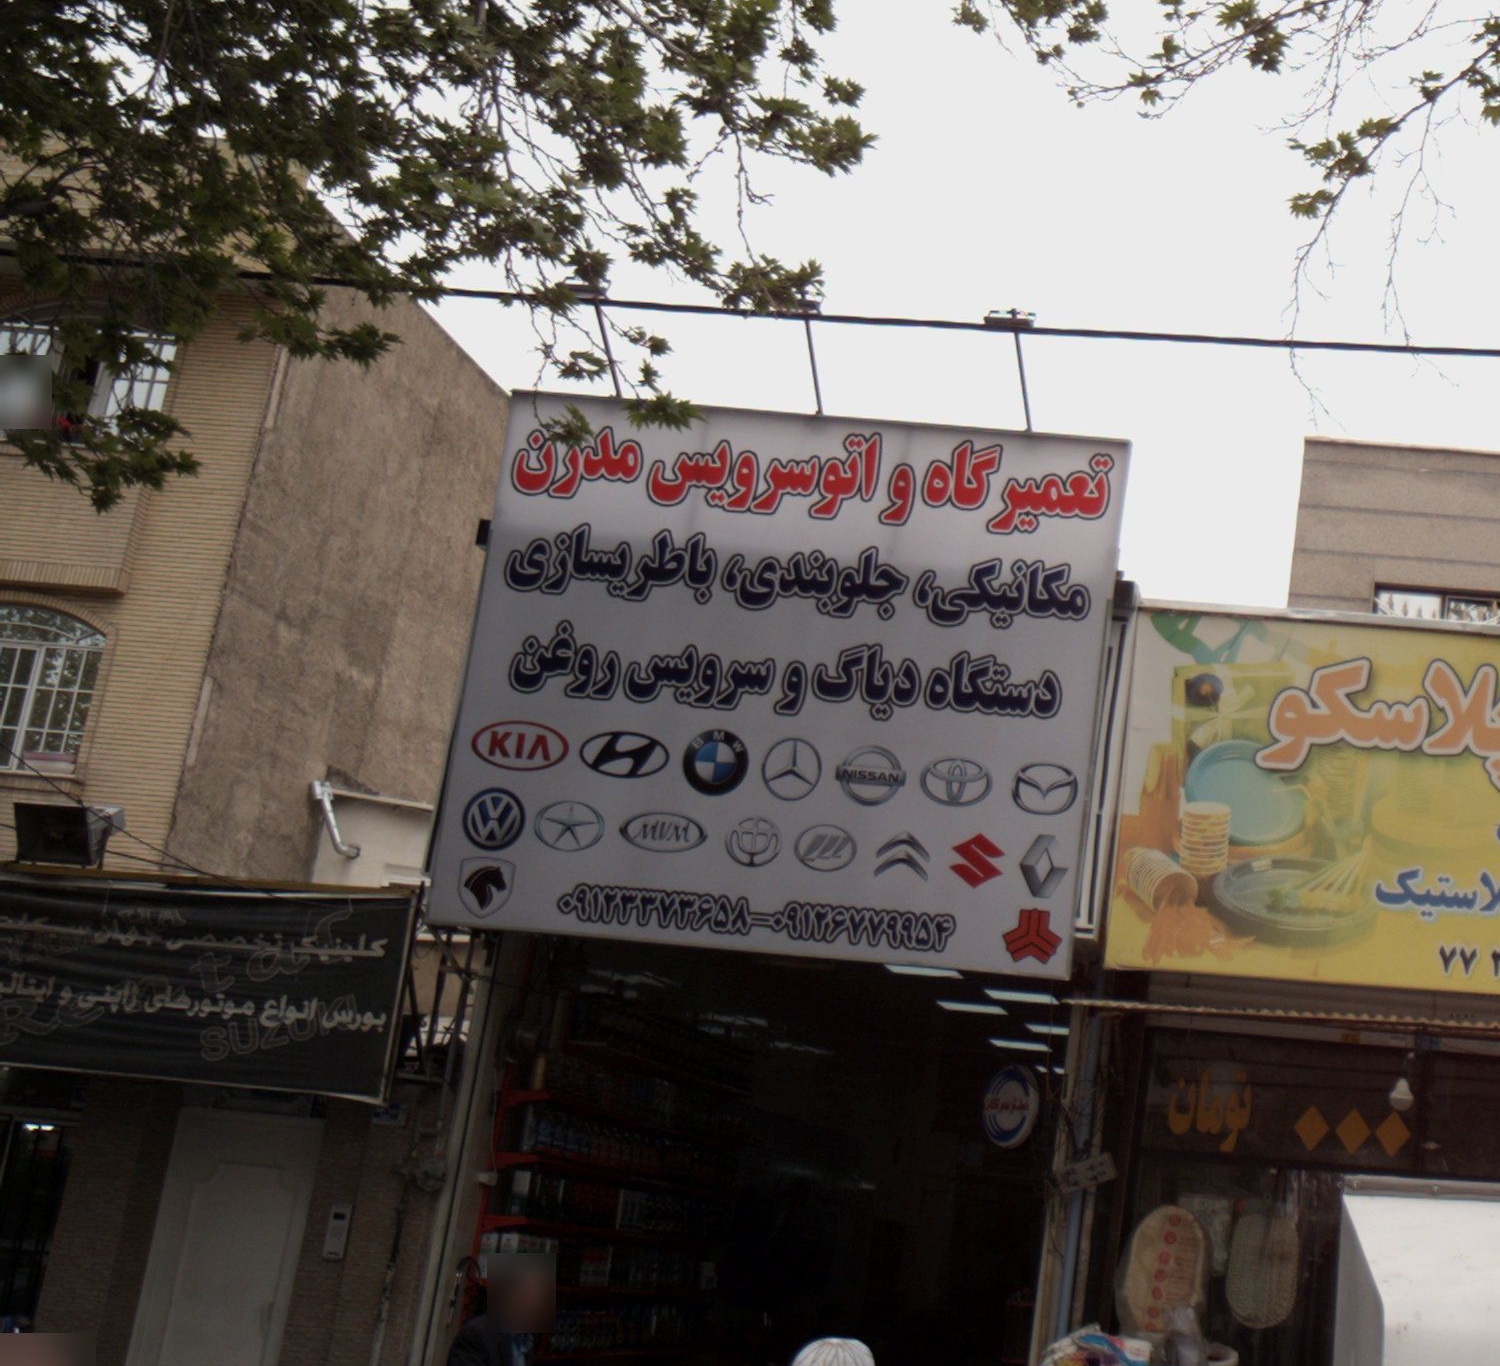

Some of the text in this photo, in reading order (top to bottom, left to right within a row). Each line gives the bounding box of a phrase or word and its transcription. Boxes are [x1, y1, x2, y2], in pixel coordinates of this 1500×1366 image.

[510, 425, 1115, 533] تعمیرگاه و اتوسرویس مدرن
[508, 621, 1063, 719] دستگاه دیاگ و سرویس روغن
[487, 730, 550, 763] KIA
[841, 768, 900, 784] NISSAN
[58, 985, 73, 1007] و
[144, 985, 256, 1021] موتورهای
[259, 994, 319, 1028] انواع
[322, 1008, 388, 1033] بورس
[1167, 1068, 1253, 1154] تومان
